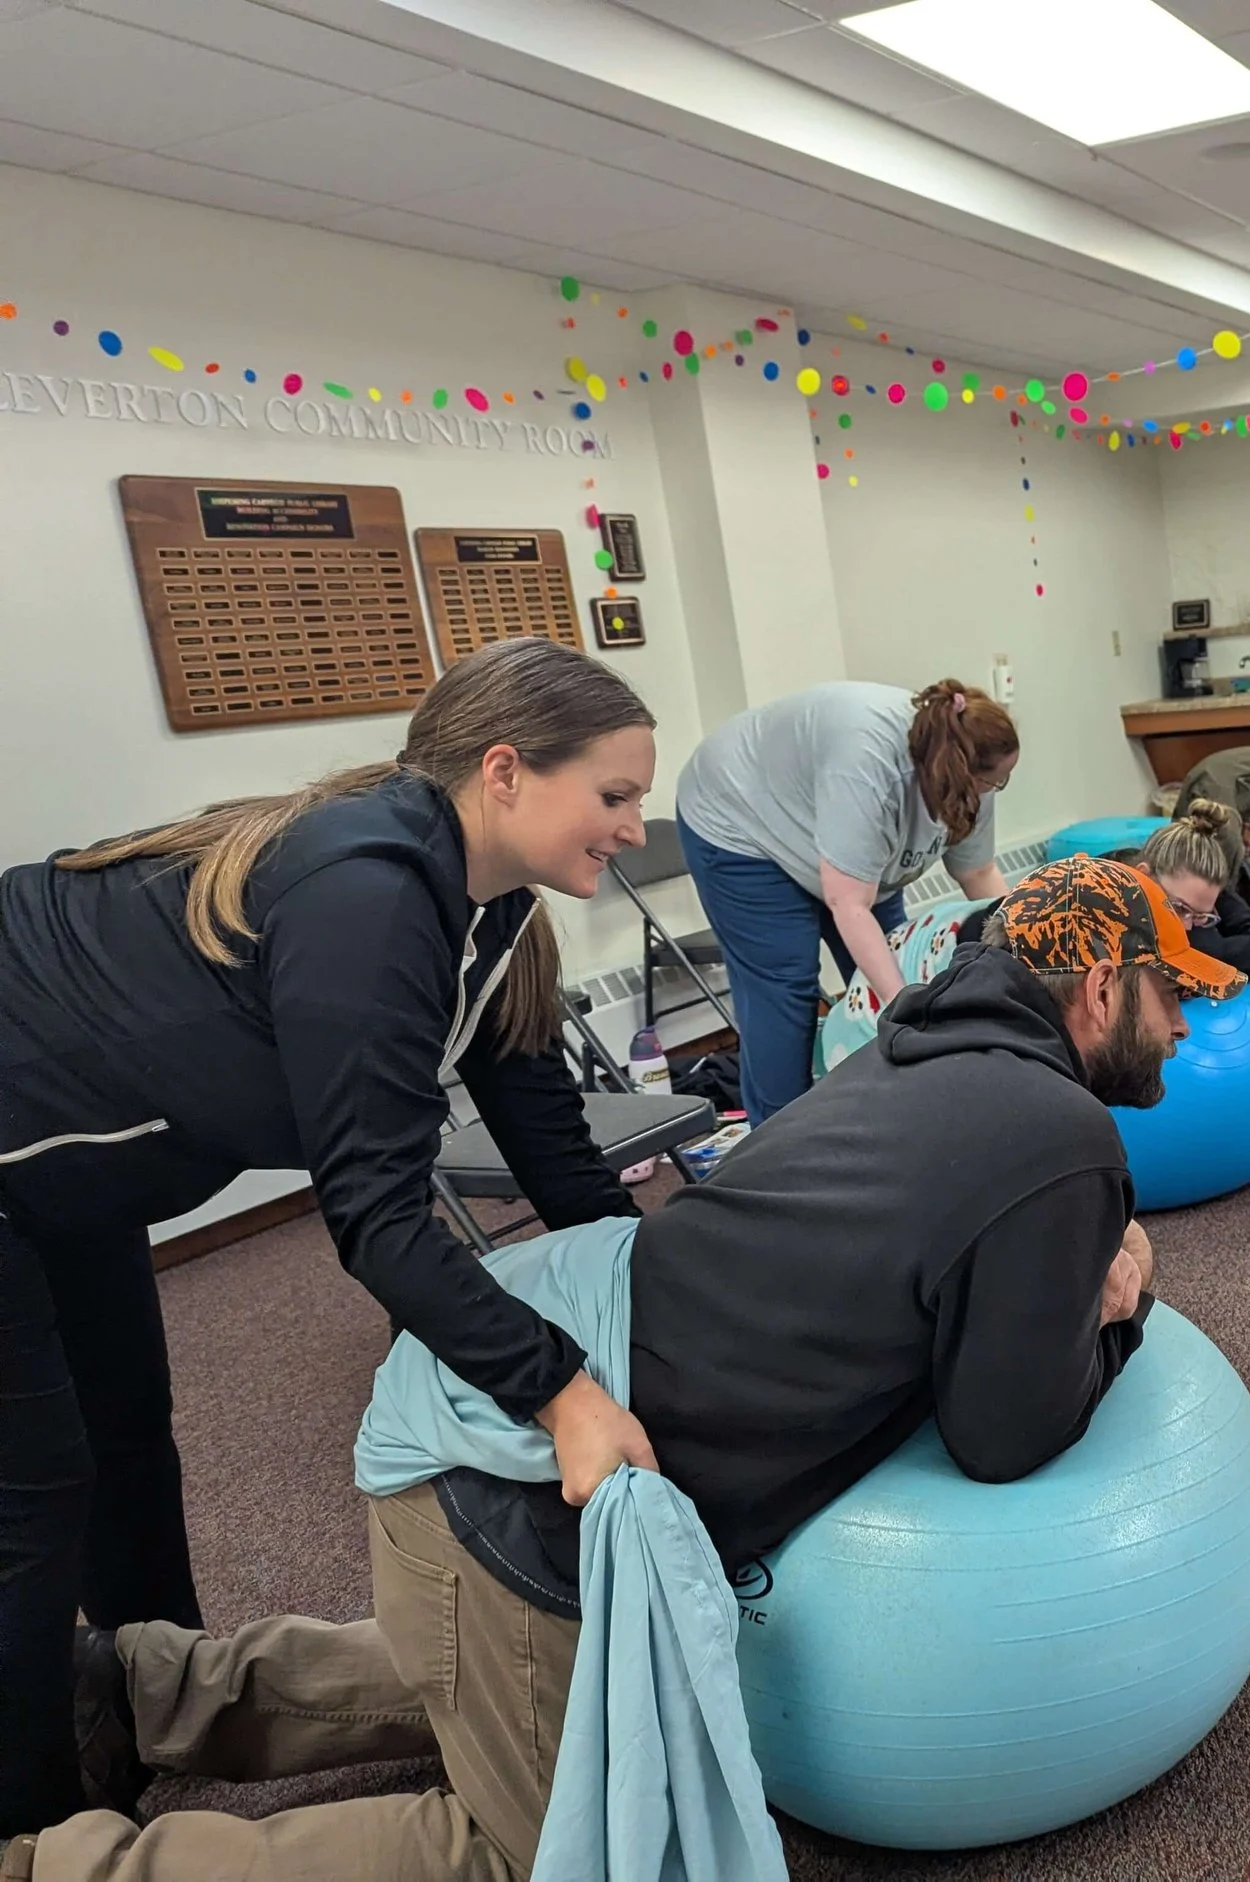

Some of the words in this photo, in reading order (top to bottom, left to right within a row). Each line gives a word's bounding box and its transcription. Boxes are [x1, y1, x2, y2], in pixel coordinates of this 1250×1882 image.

[0, 371, 249, 430] EVERTON
[264, 396, 512, 450] COMMUNITY
[521, 422, 615, 461] ROOM
[739, 1605, 768, 1626] TIC
